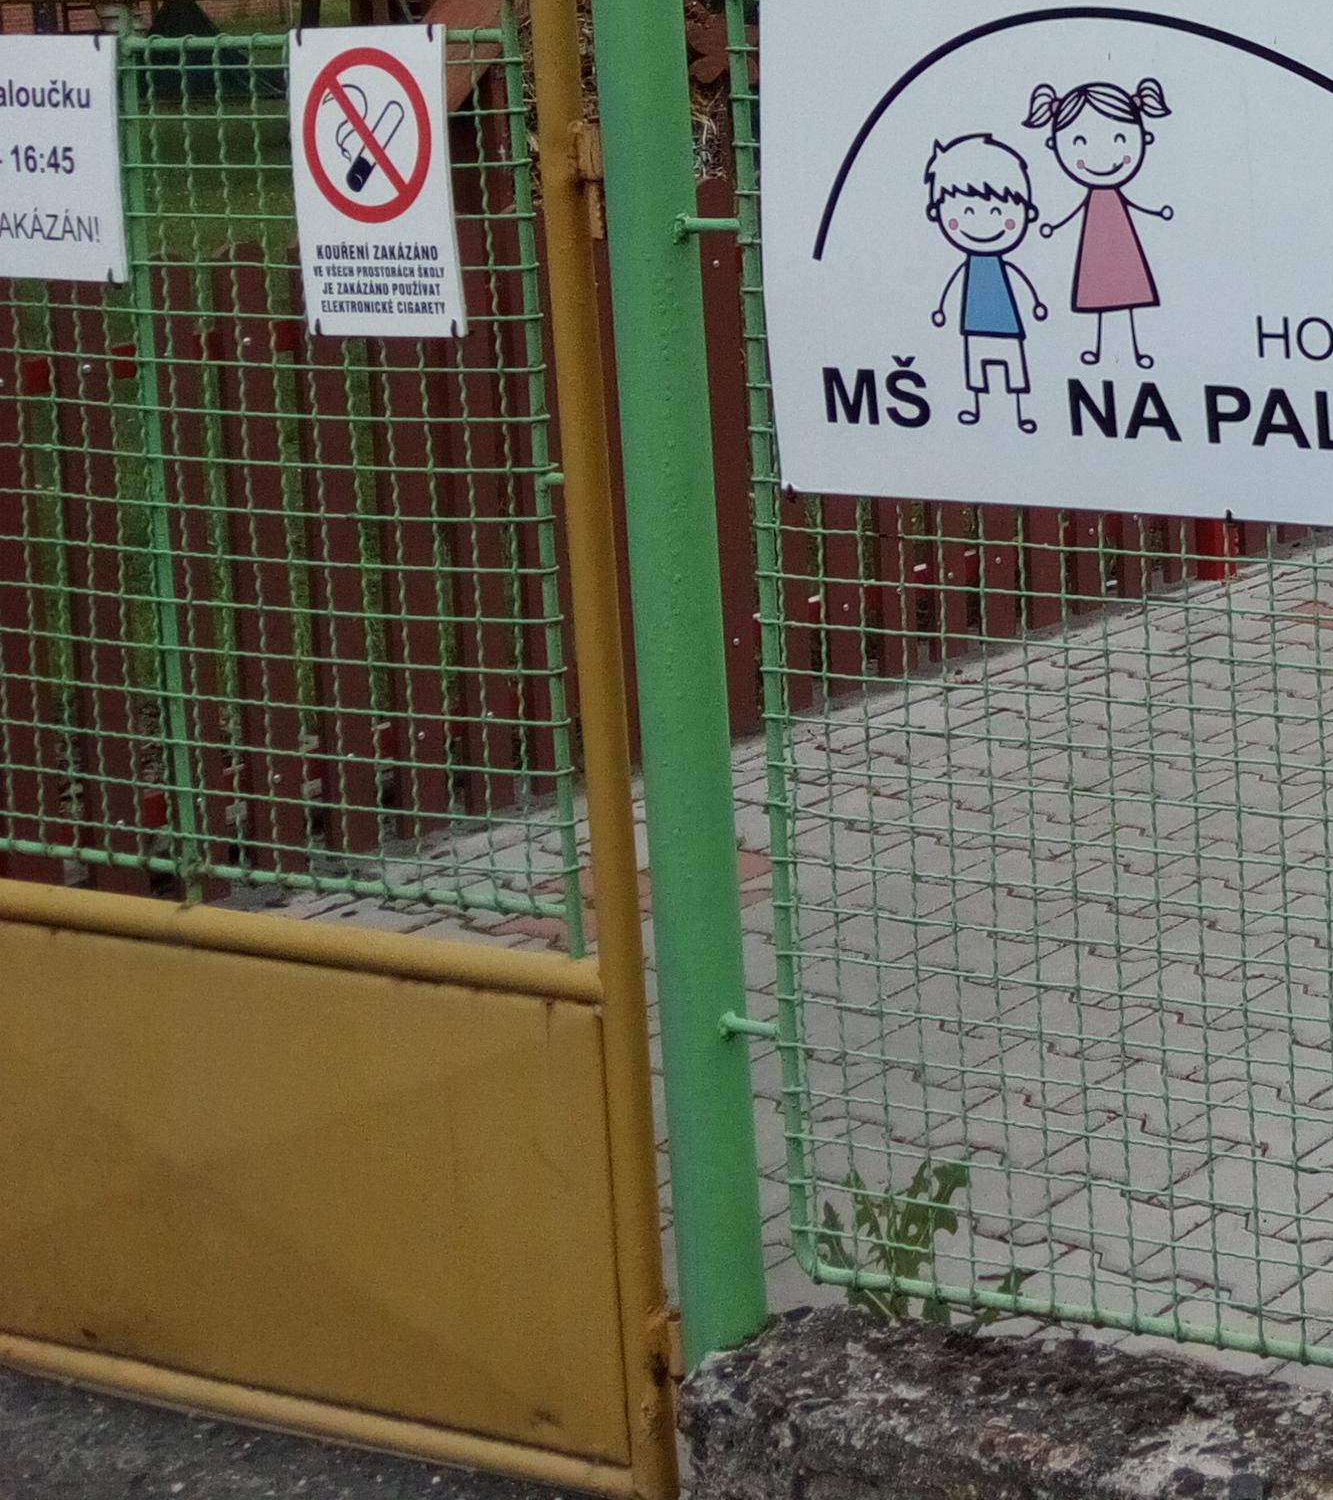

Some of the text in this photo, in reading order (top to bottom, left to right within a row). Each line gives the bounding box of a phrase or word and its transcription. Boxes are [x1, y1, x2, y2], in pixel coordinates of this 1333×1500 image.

[0, 79, 91, 109] aloučku
[10, 145, 75, 175] 16:45
[0, 207, 100, 242] AKÁZÁN!
[316, 242, 439, 261] KOUŘENÍ ZAKÁZÁNO
[313, 264, 445, 278] VE VŠECH PROSTORÁCH ŠKOLY
[322, 280, 440, 296] JE ZAKÁZÁNO POUŽÍVAT
[322, 299, 446, 315] ELEKTRONICKÉ CIGARETY
[822, 355, 932, 429] MŠ
[1067, 378, 1183, 443] NA
